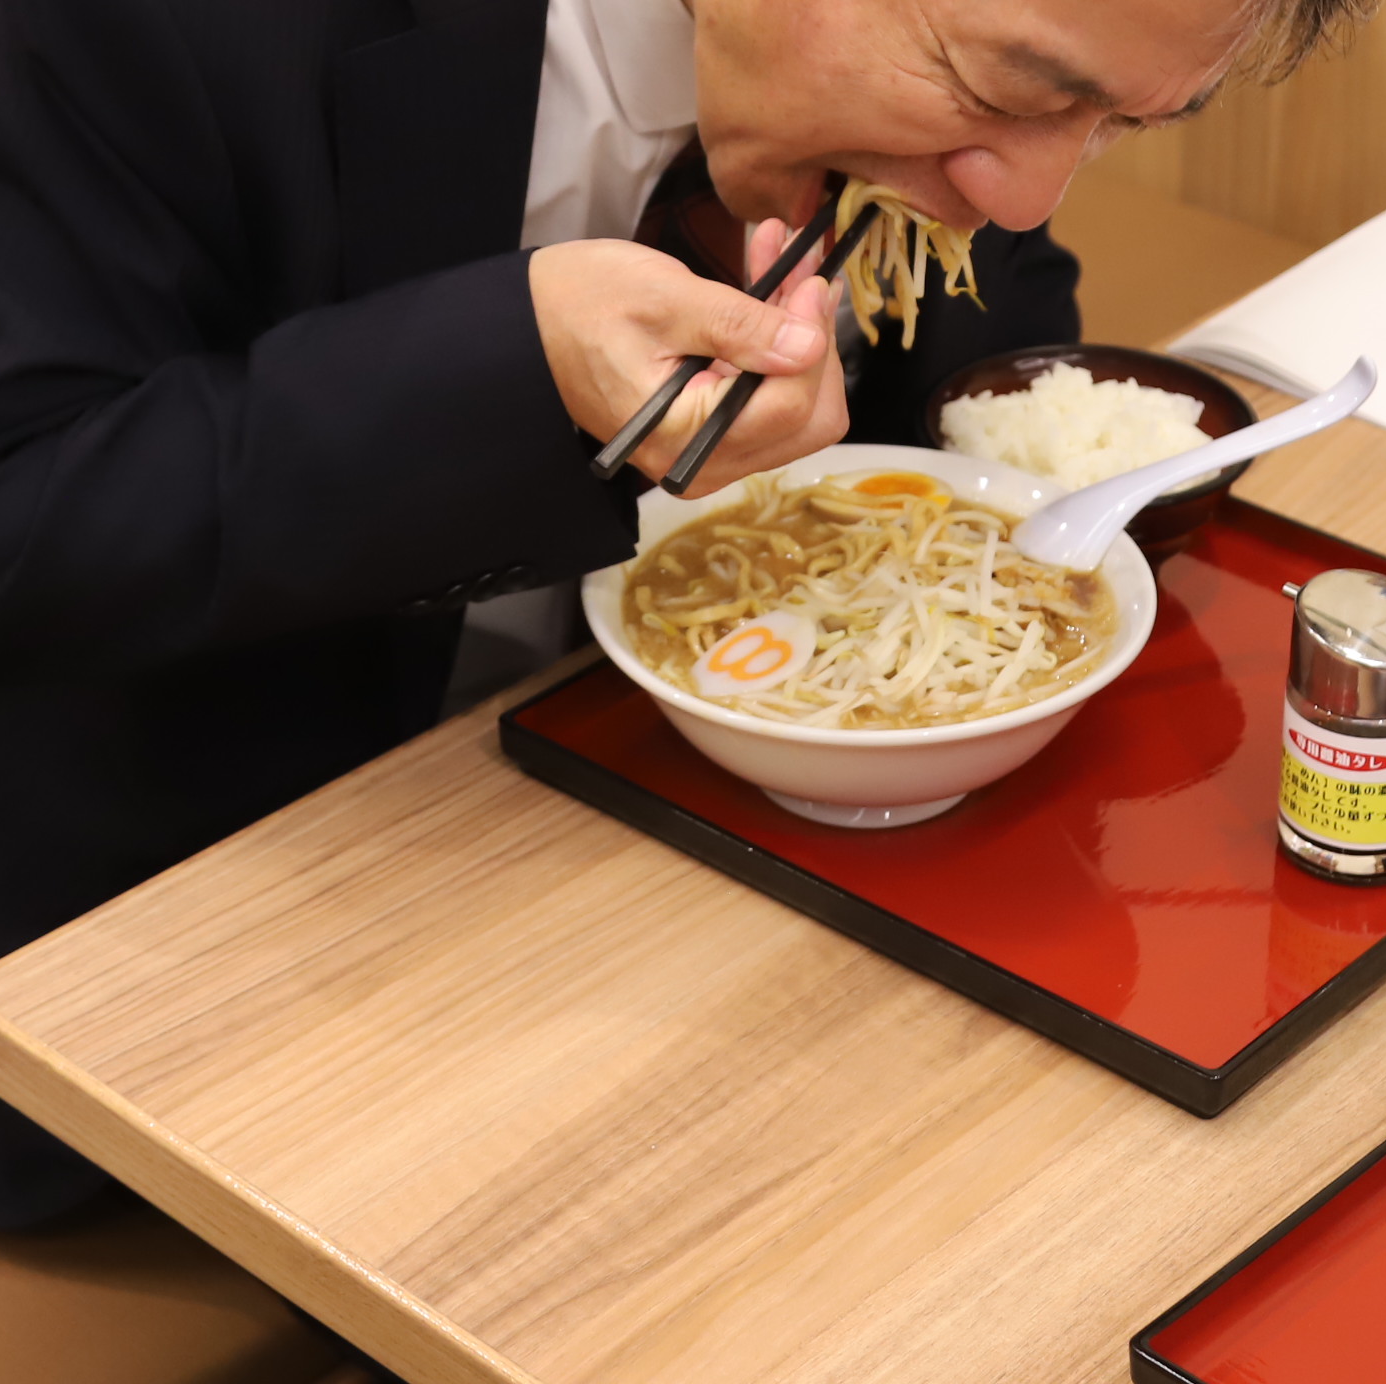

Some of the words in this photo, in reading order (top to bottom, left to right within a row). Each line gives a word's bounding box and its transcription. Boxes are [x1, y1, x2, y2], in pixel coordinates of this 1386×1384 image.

[1295, 732, 1383, 769] 専用醤油タレ
